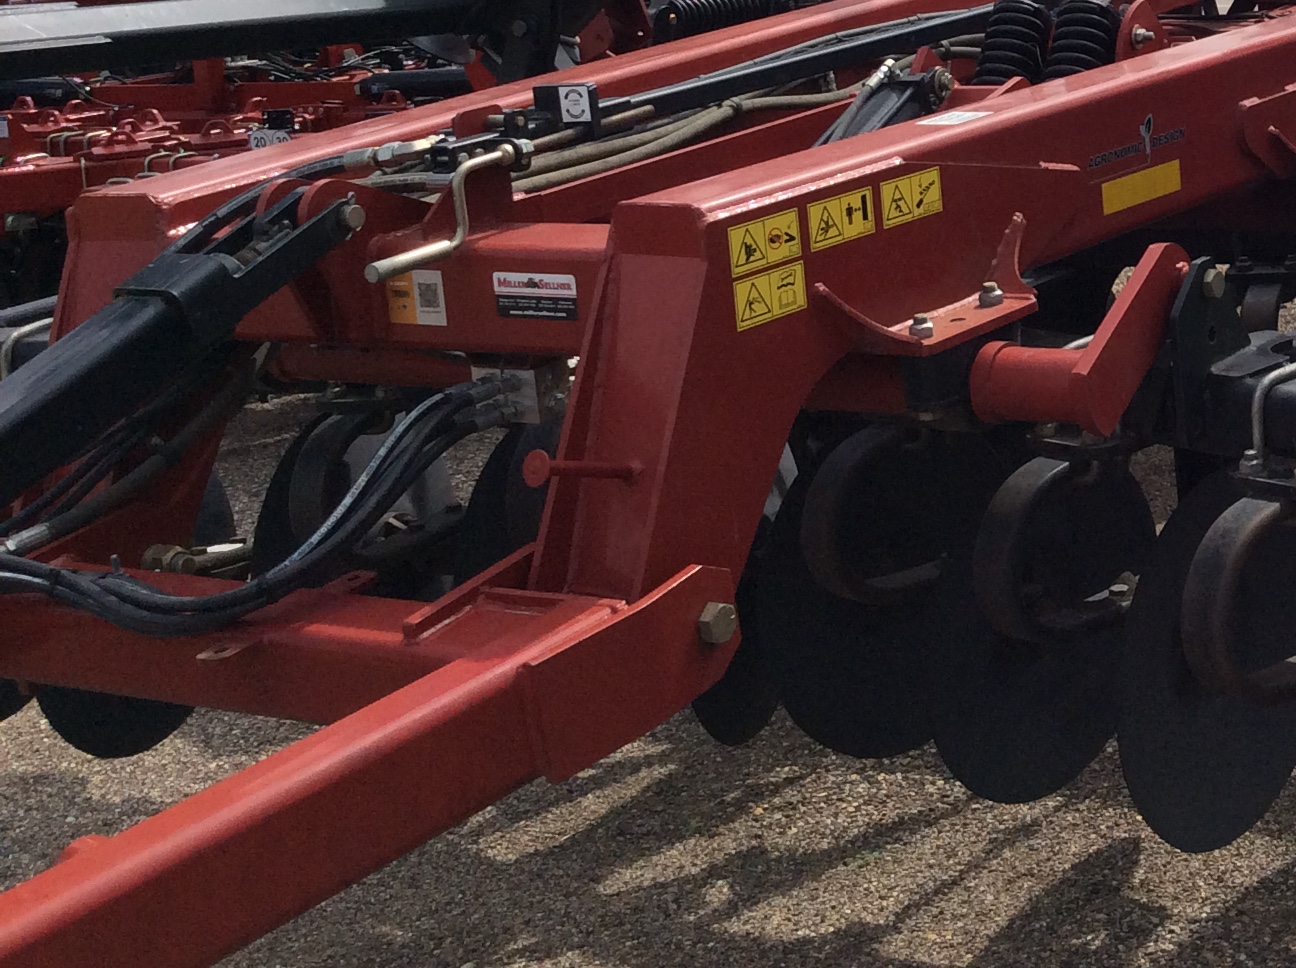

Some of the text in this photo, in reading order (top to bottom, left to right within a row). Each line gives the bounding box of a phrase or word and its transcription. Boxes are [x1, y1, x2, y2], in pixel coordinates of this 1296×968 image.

[253, 136, 267, 148] 20
[1087, 127, 1185, 168] AGRONOMIC DESIGN
